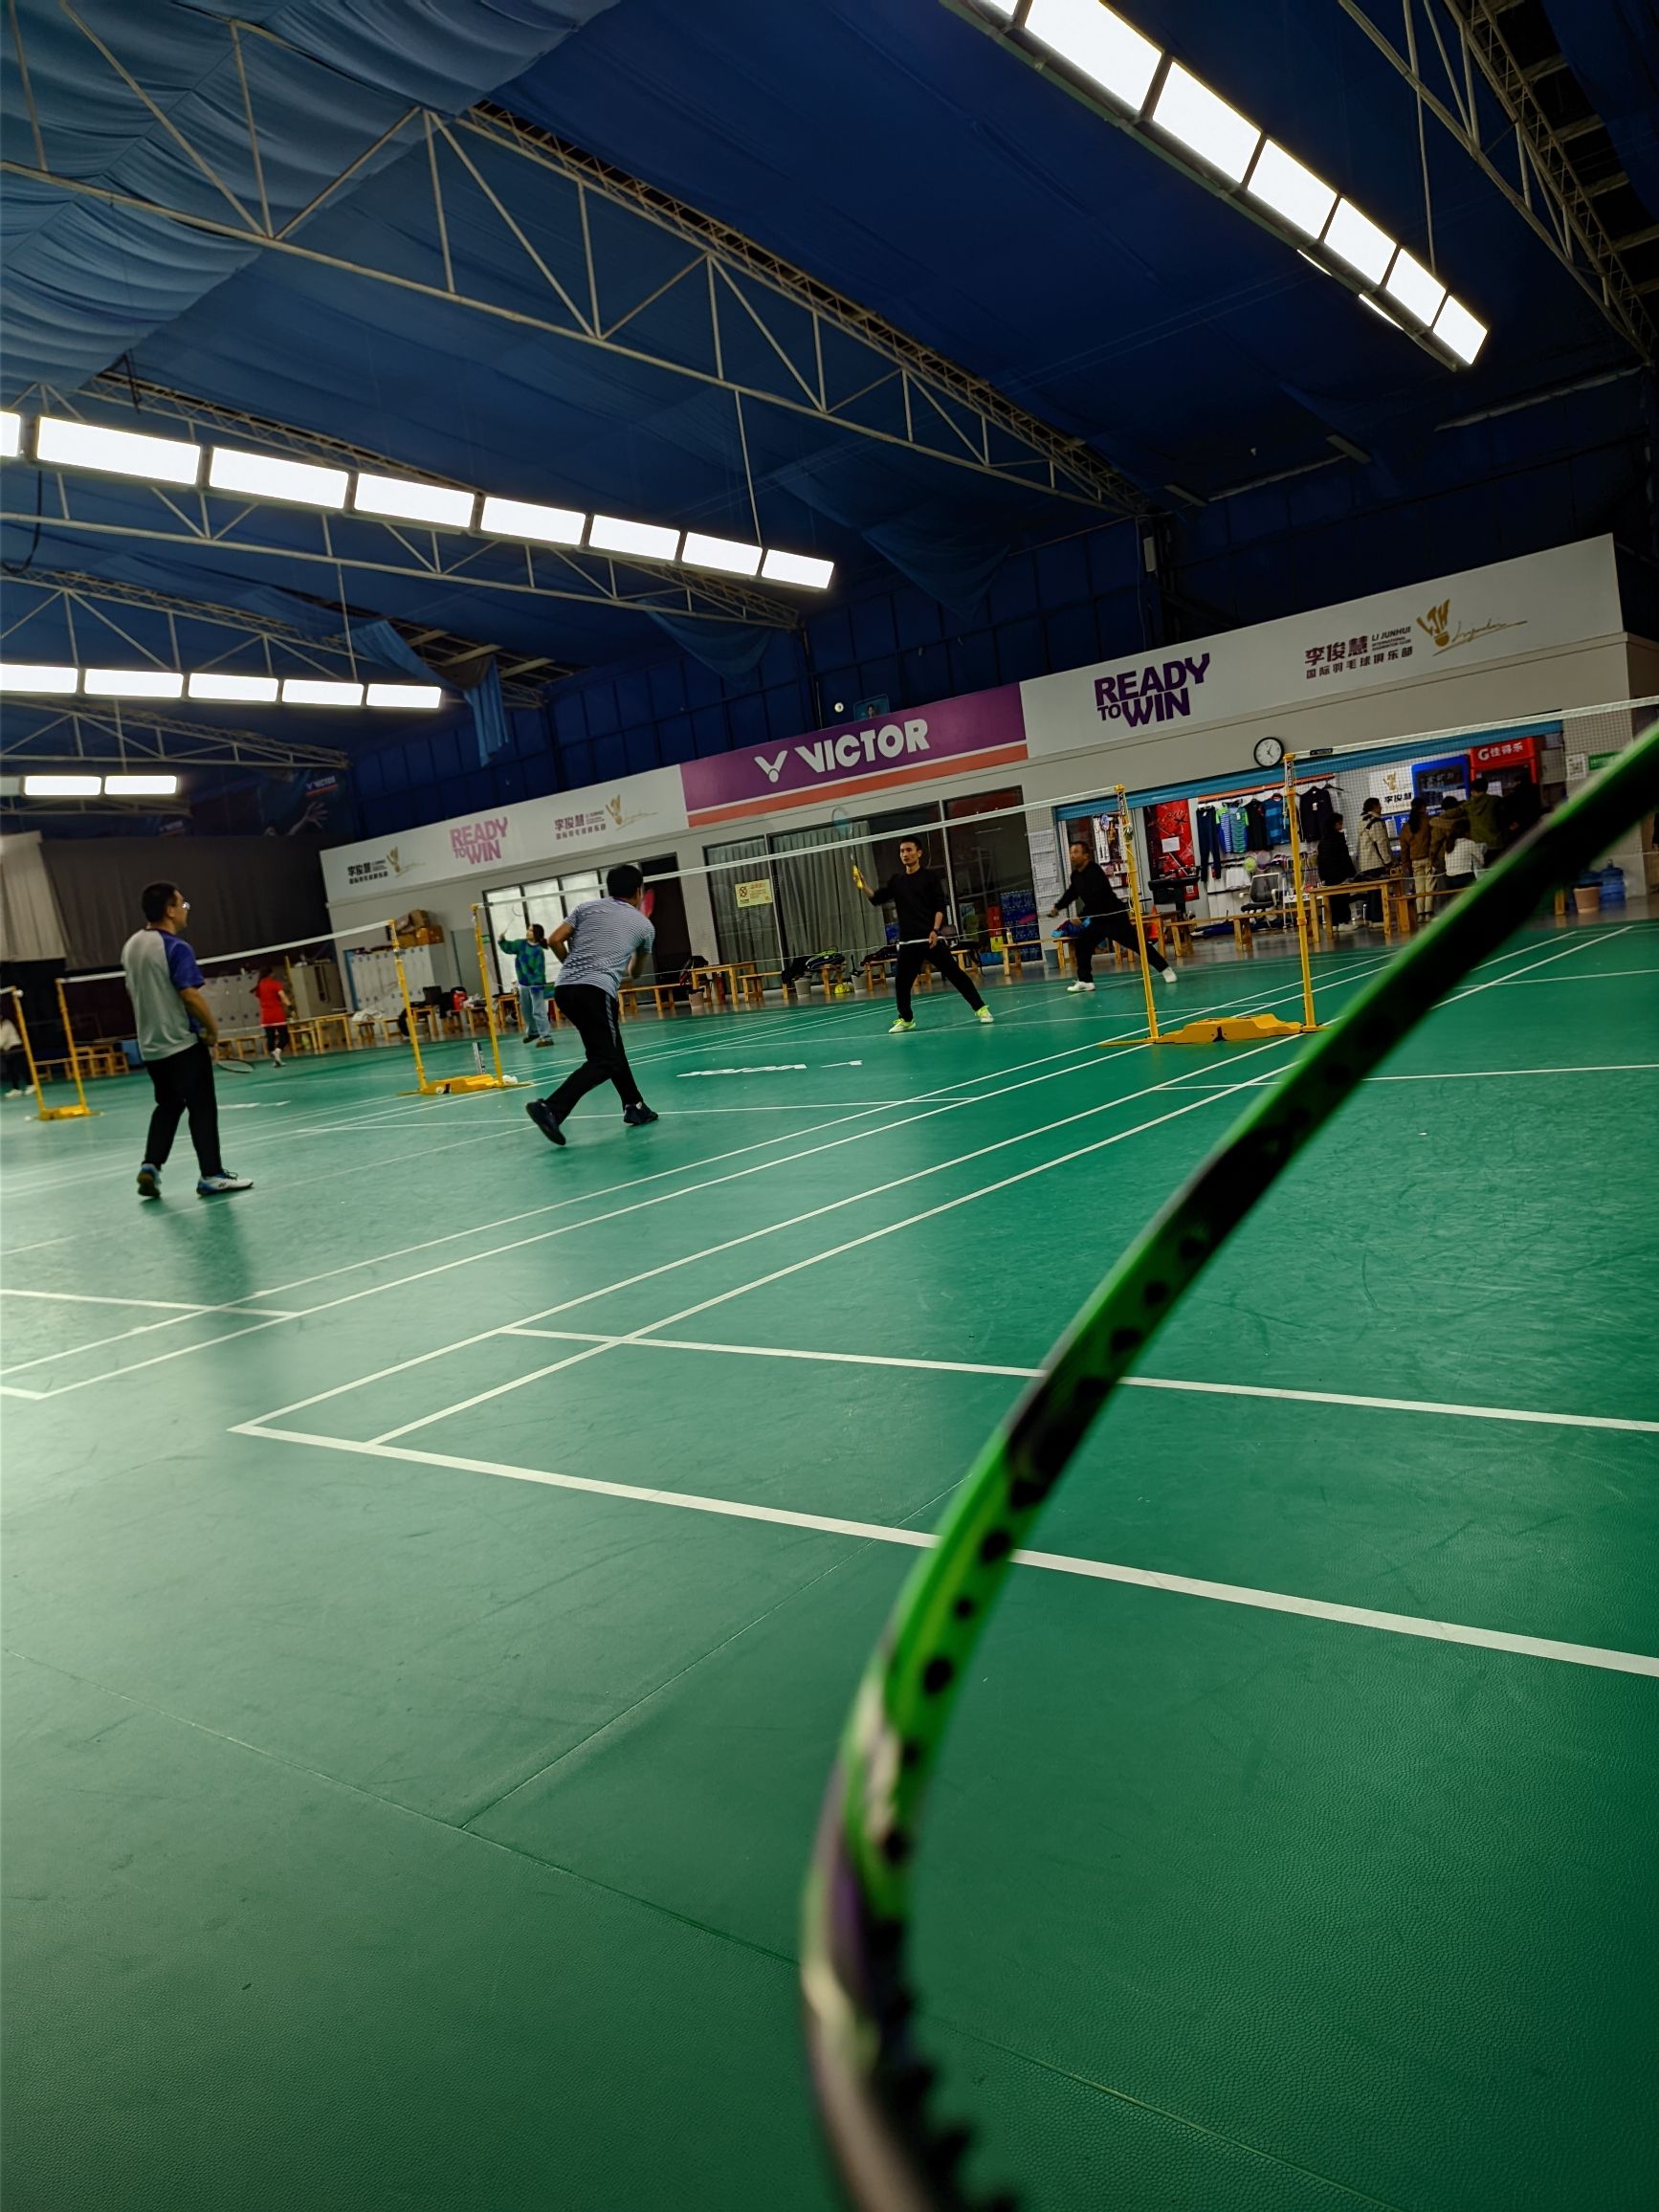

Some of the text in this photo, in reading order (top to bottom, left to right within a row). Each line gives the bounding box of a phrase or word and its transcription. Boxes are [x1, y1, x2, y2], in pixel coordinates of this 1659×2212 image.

[1381, 626, 1412, 640] JUNHUI
[1304, 635, 1368, 666] 李俊慧
[1306, 646, 1413, 679] 国际羽毛球俱乐部
[1094, 653, 1210, 707] READY
[1097, 687, 1191, 728] TO WIN
[794, 718, 931, 773] VICTOR
[449, 816, 508, 849] READY
[453, 839, 502, 865] TO WIN
